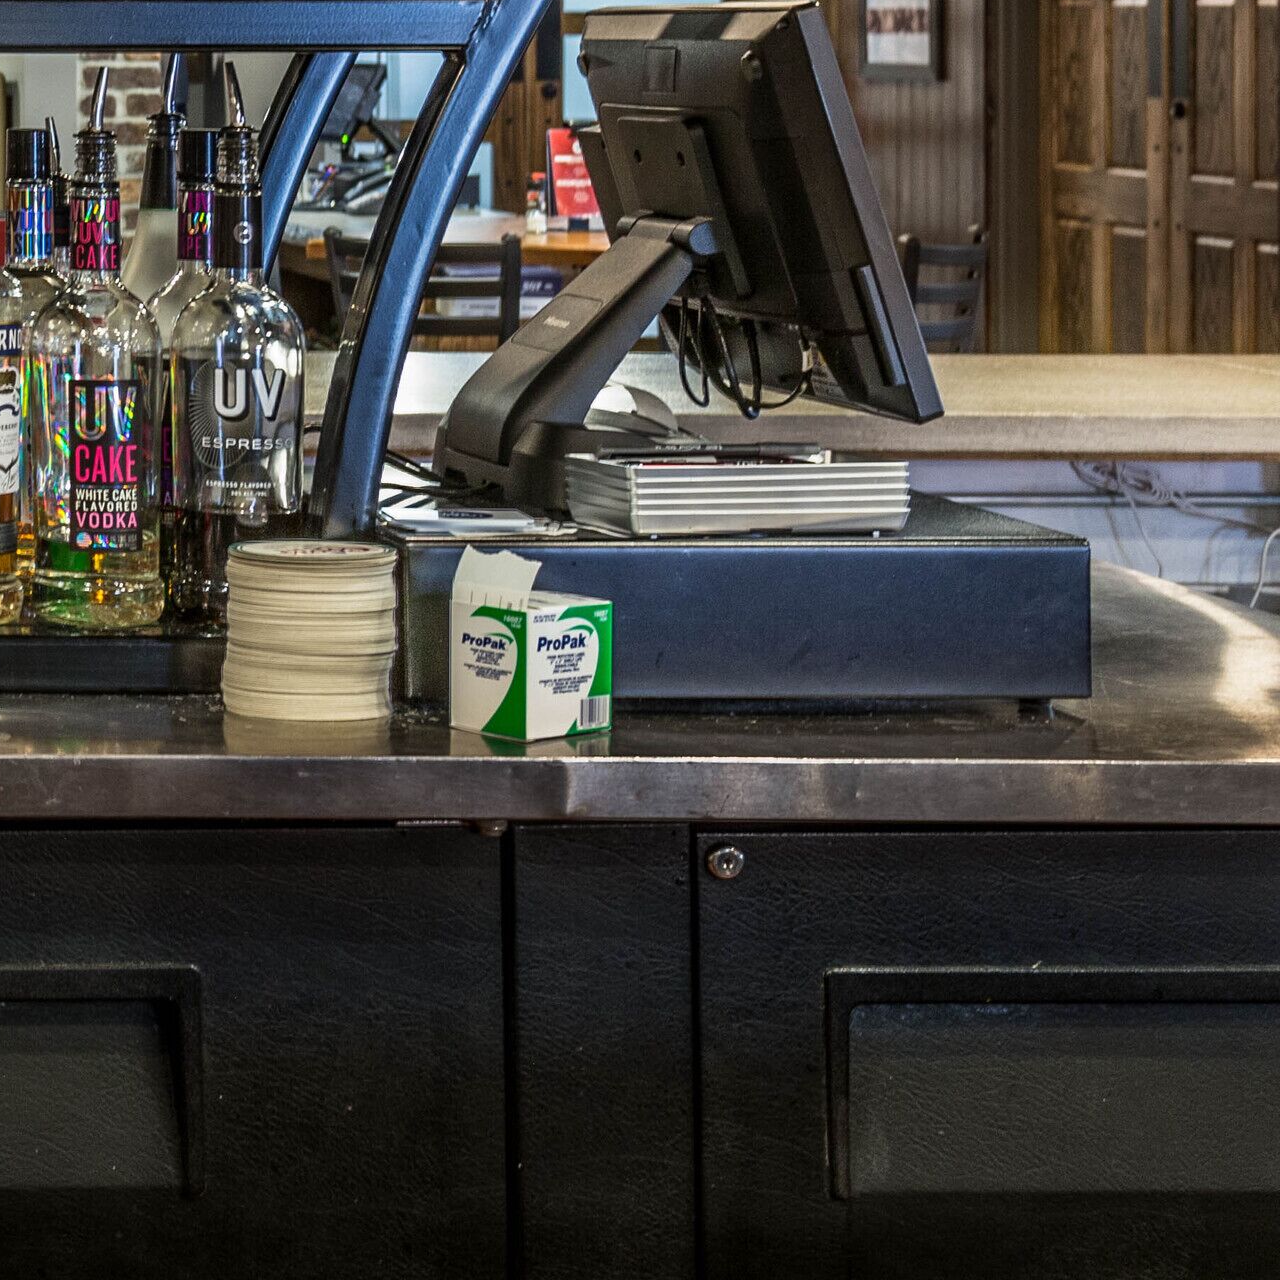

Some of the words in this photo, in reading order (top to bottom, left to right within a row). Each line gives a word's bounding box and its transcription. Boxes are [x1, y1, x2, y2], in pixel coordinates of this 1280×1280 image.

[75, 244, 118, 269] CAKE
[213, 368, 287, 421] UV
[74, 386, 137, 442] UV
[74, 443, 138, 483] CAKE
[75, 488, 111, 502] WHITE
[112, 486, 138, 502] CAKE
[75, 500, 138, 513] FLAVORED
[76, 511, 138, 529] VODKA
[461, 632, 507, 651] ProPak
[536, 634, 587, 653] ProPak
